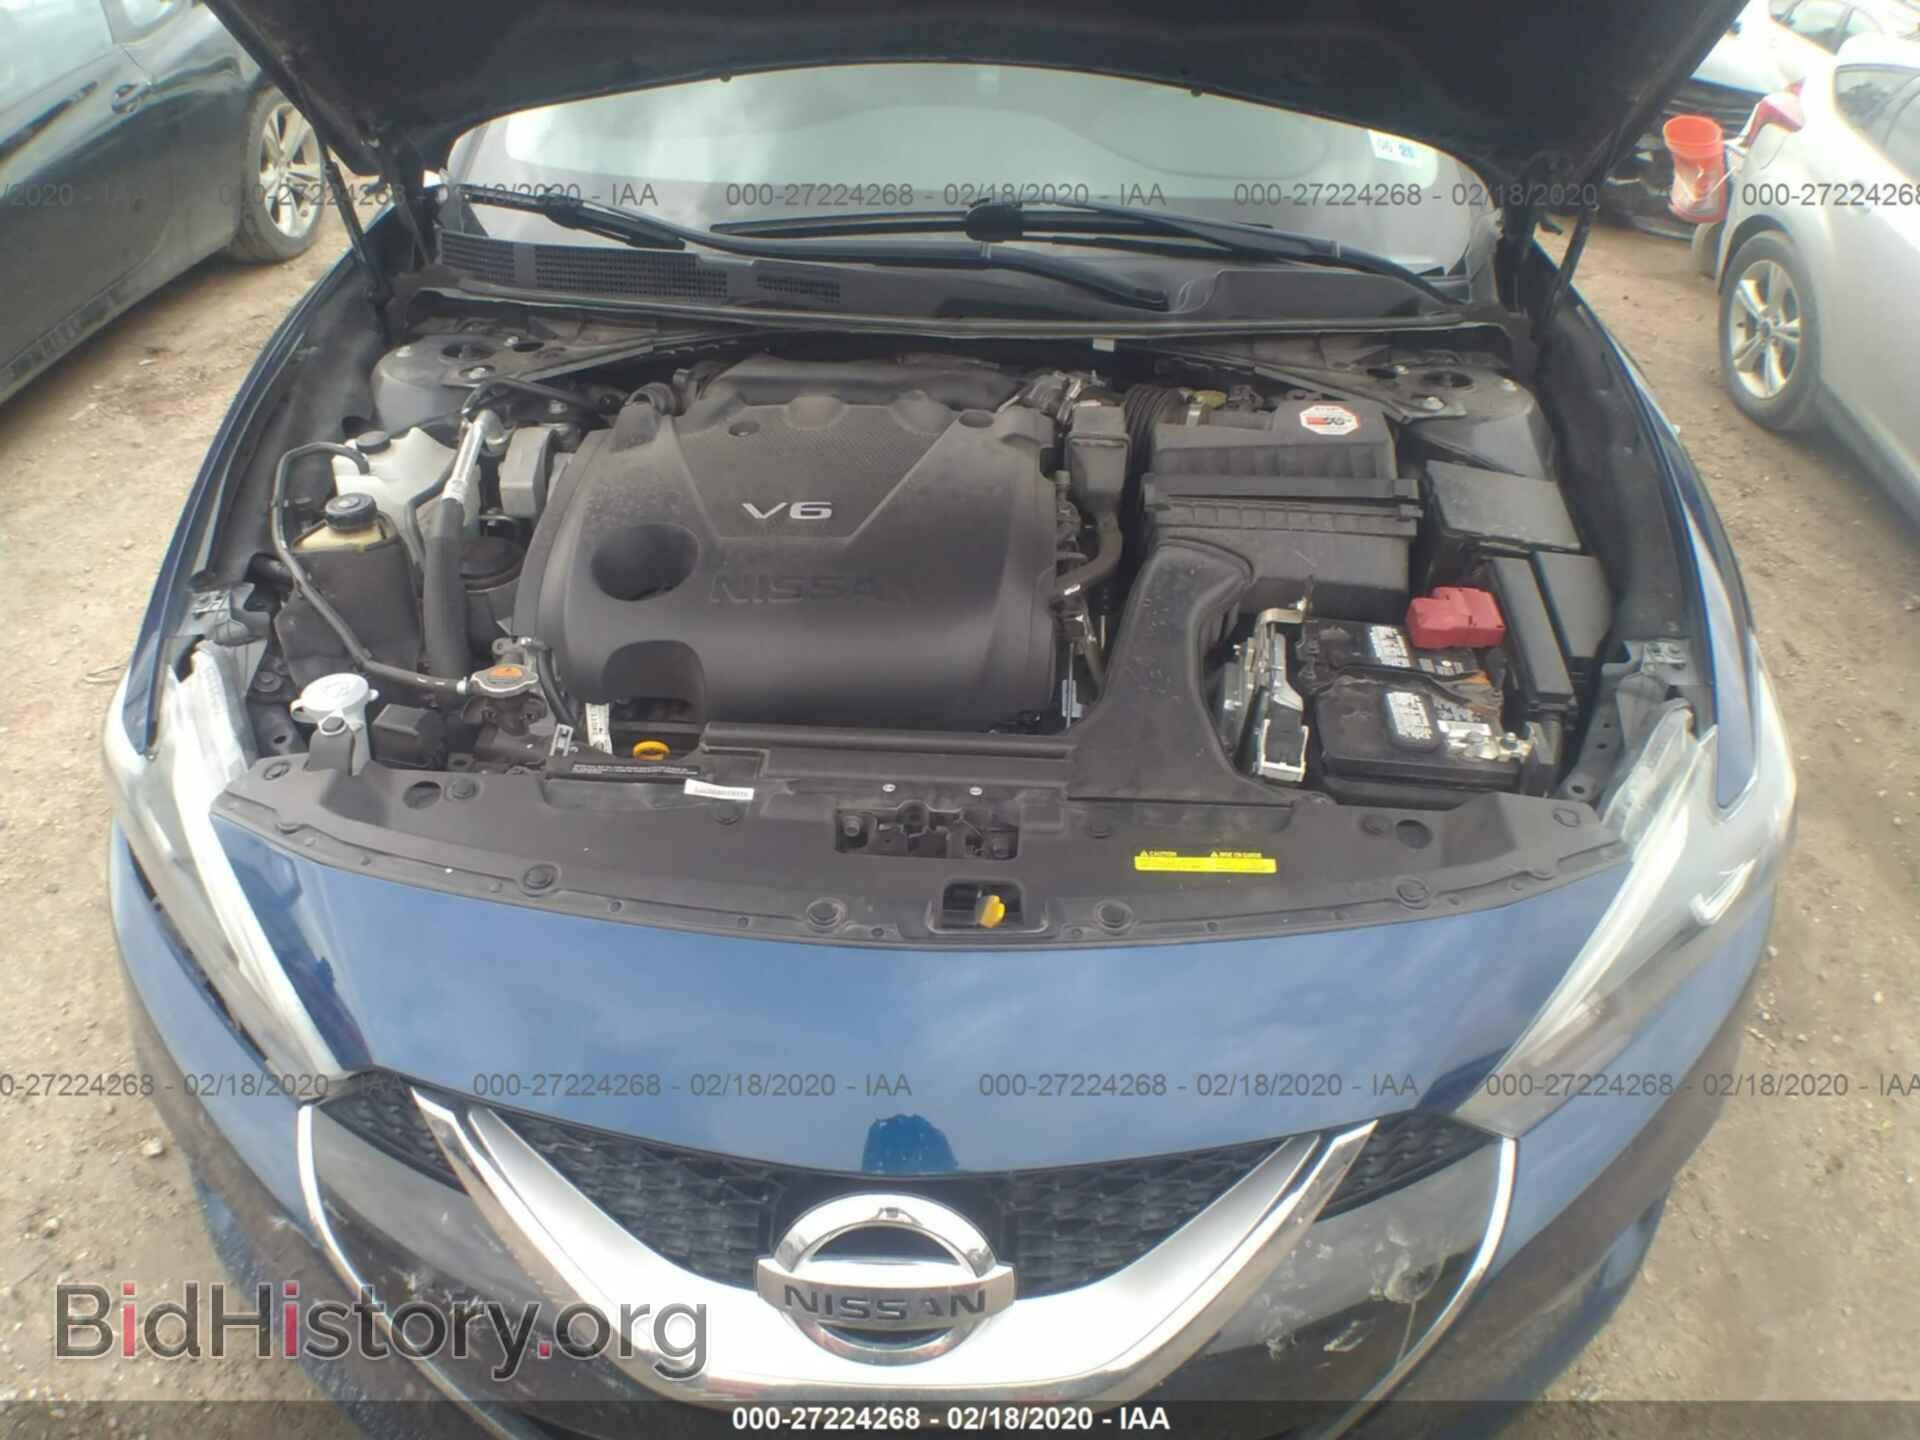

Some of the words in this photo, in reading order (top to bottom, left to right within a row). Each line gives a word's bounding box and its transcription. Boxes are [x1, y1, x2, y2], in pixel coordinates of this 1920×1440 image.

[741, 501, 833, 520] V6
[710, 574, 918, 604] NISSA
[783, 1284, 986, 1320] NISSAN
